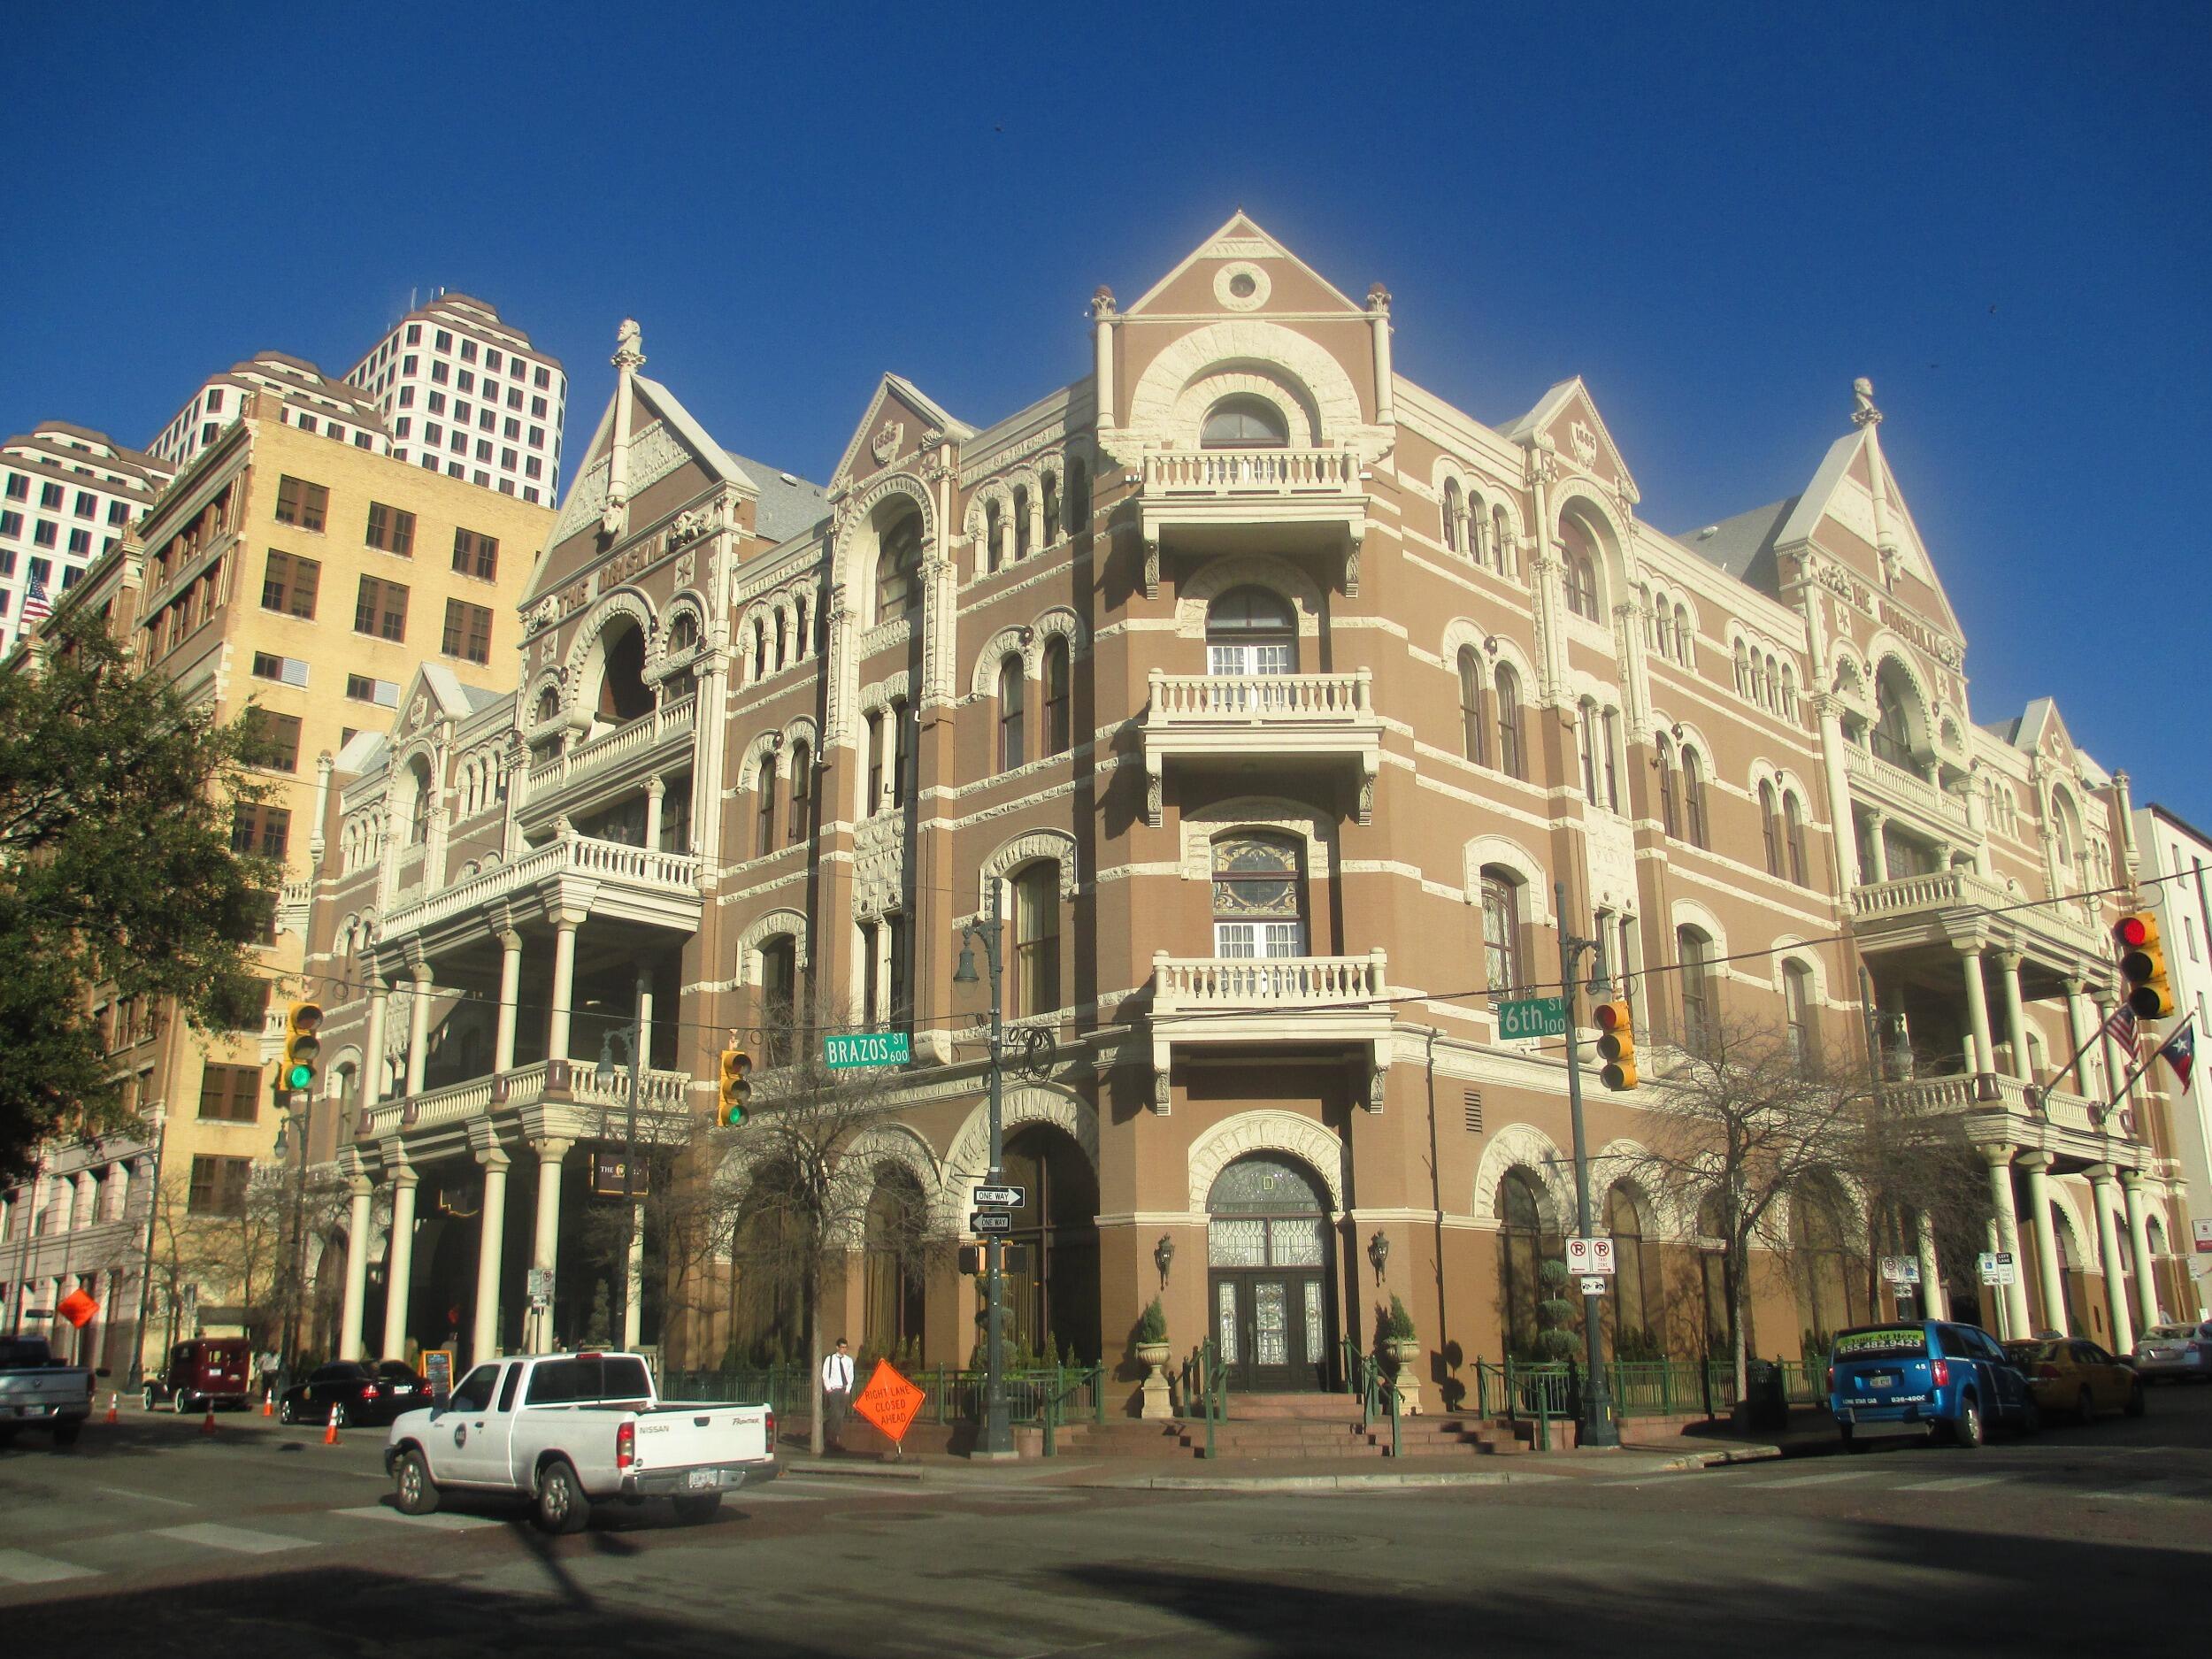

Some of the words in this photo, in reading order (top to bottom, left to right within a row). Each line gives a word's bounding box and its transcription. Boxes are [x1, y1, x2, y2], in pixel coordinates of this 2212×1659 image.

[558, 577, 588, 618] THE
[1506, 1004, 1543, 1033] 6th
[1549, 997, 1563, 1011] ST
[1544, 1018, 1565, 1033] 100
[827, 1038, 888, 1064] BRAZOS
[893, 1033, 904, 1044] ST
[889, 1049, 908, 1062] 600
[600, 1165, 614, 1174] THE
[979, 1191, 993, 1200] ONE
[995, 1192, 1009, 1201] WAY
[981, 1217, 993, 1226] ONE
[864, 1388, 887, 1401] RIGHT
[890, 1385, 910, 1397] LANE
[875, 1399, 906, 1413] CLOSED
[880, 1412, 906, 1425] AHEAD
[639, 1425, 670, 1433] NISSAN
